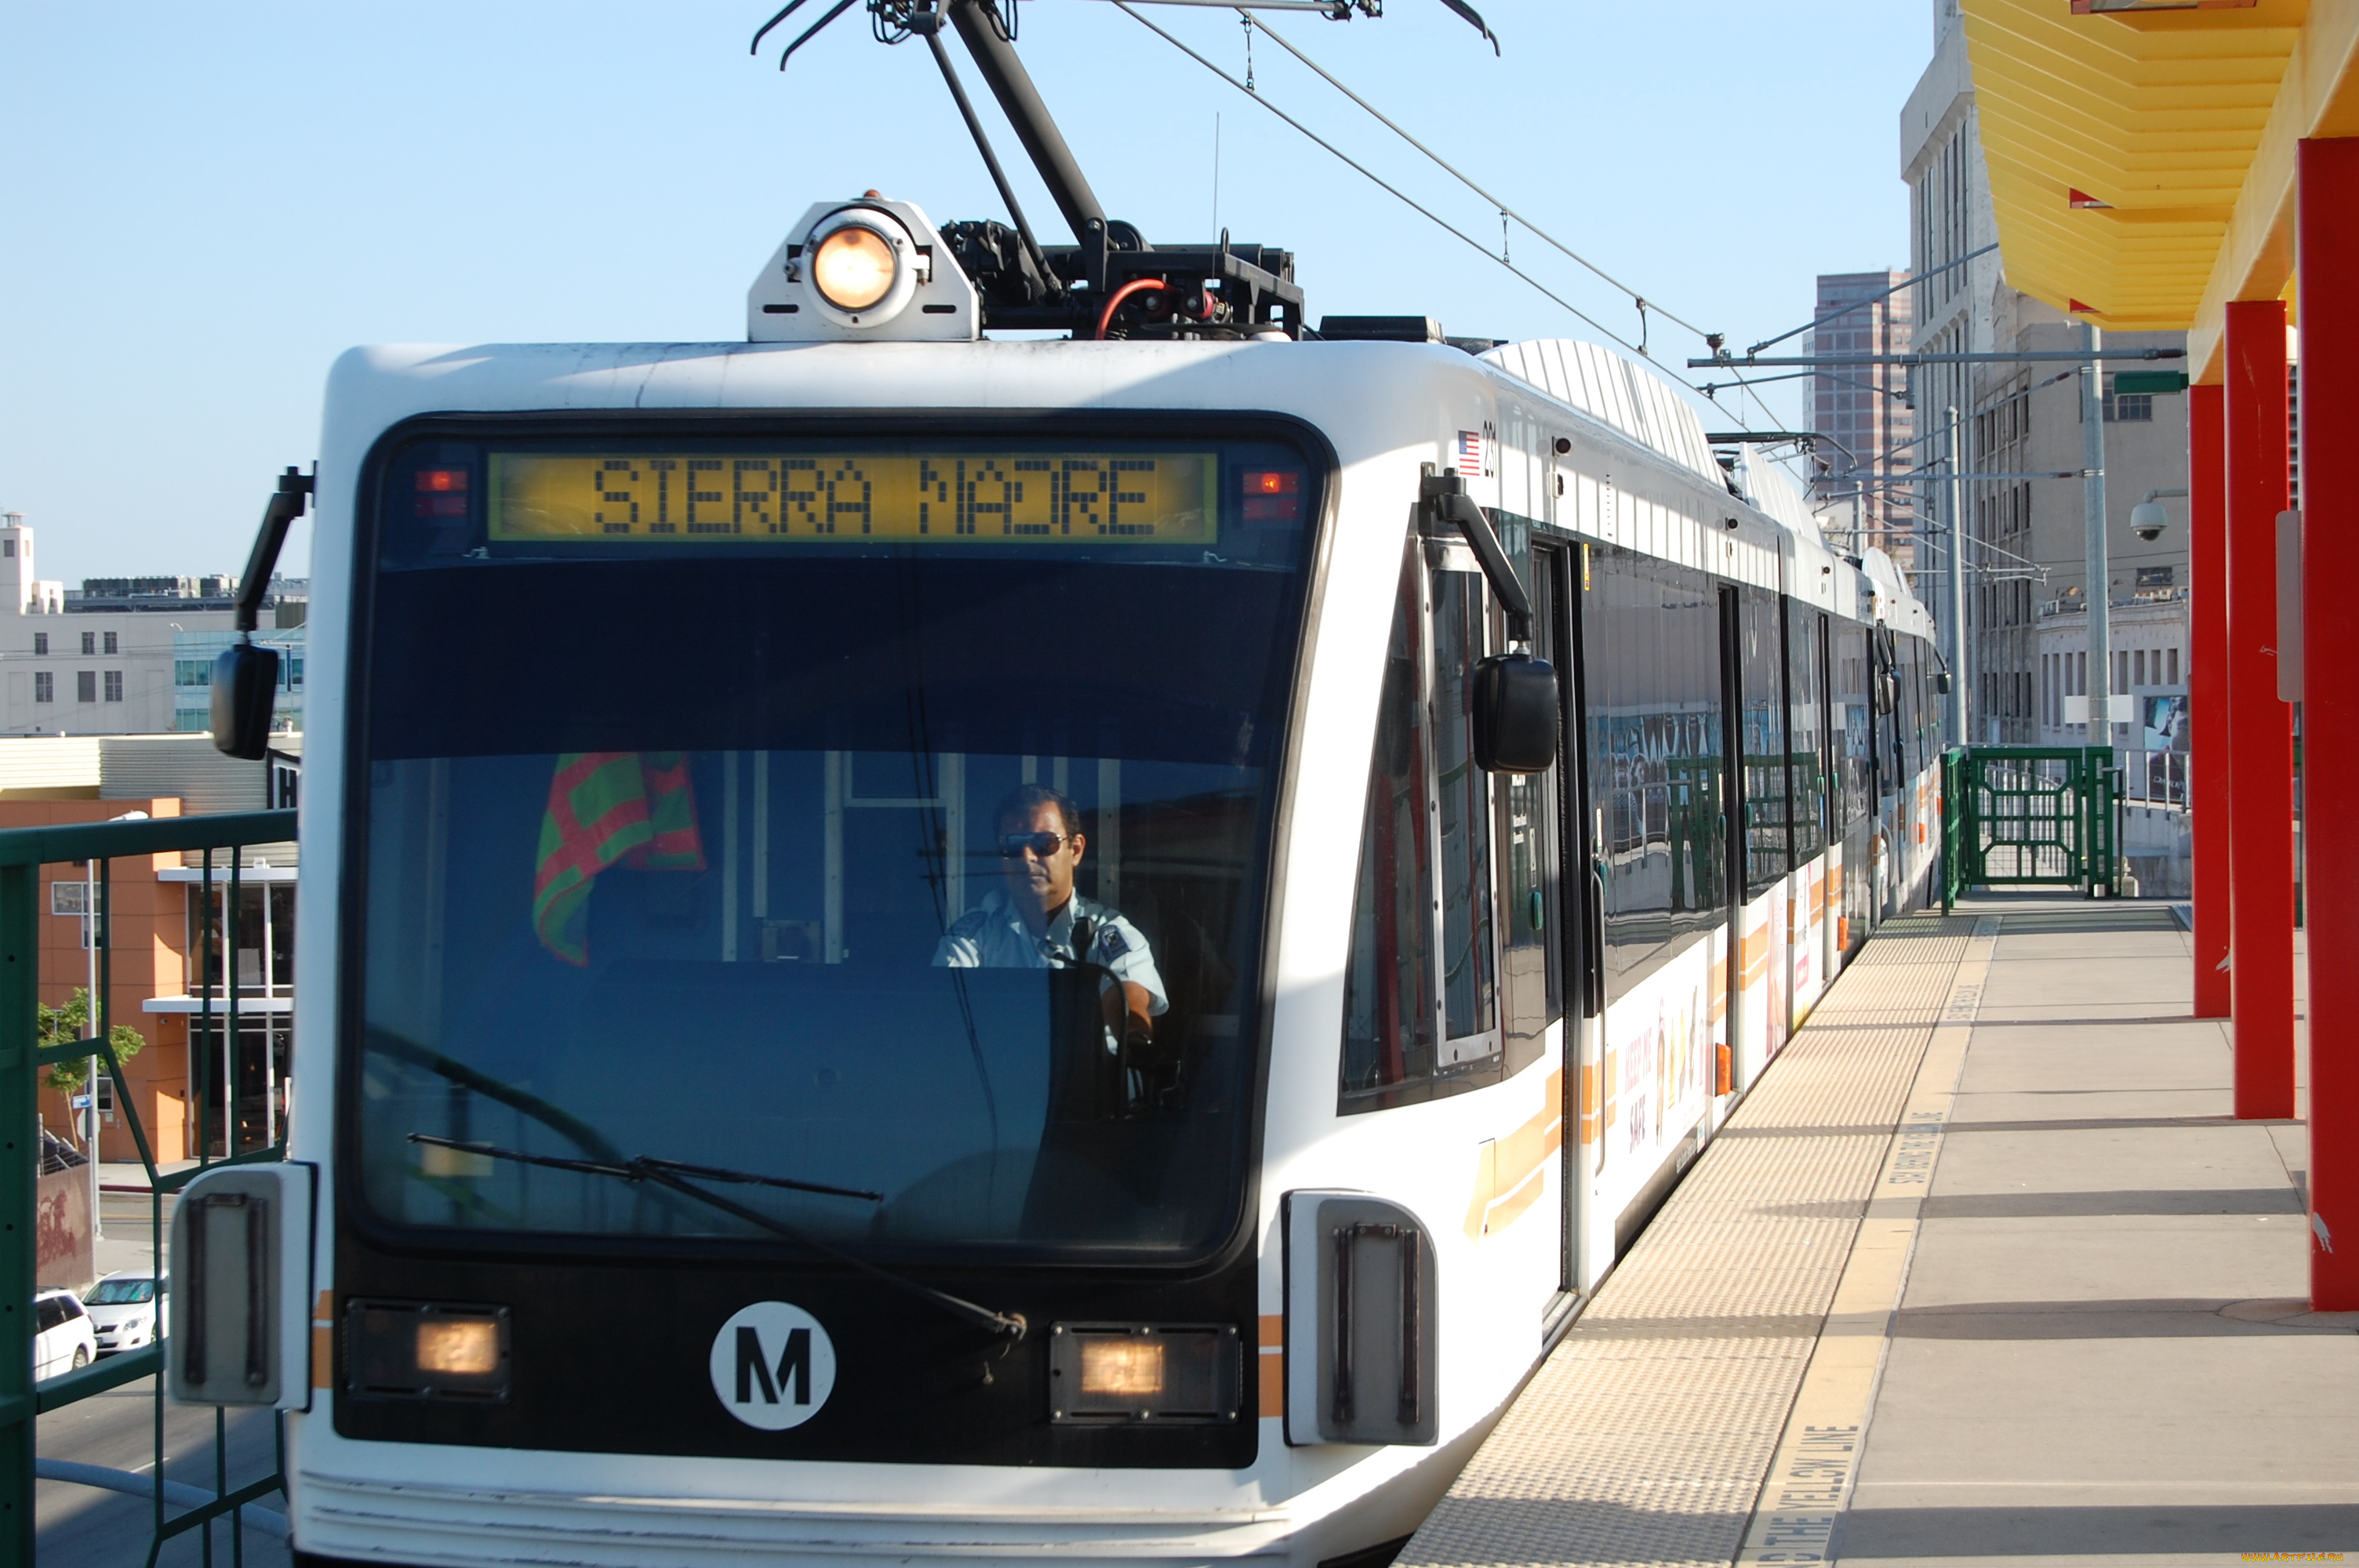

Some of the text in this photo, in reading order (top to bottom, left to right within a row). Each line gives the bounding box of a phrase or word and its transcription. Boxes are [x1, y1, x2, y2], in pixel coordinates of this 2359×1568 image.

[595, 459, 871, 534] SIERRA
[1630, 1094, 1645, 1154] SAFE
[736, 1326, 811, 1404] M
[1797, 1425, 1859, 1452] LINE
[1776, 1457, 1849, 1511] YELLOW
[1764, 1517, 1833, 1546] THE
